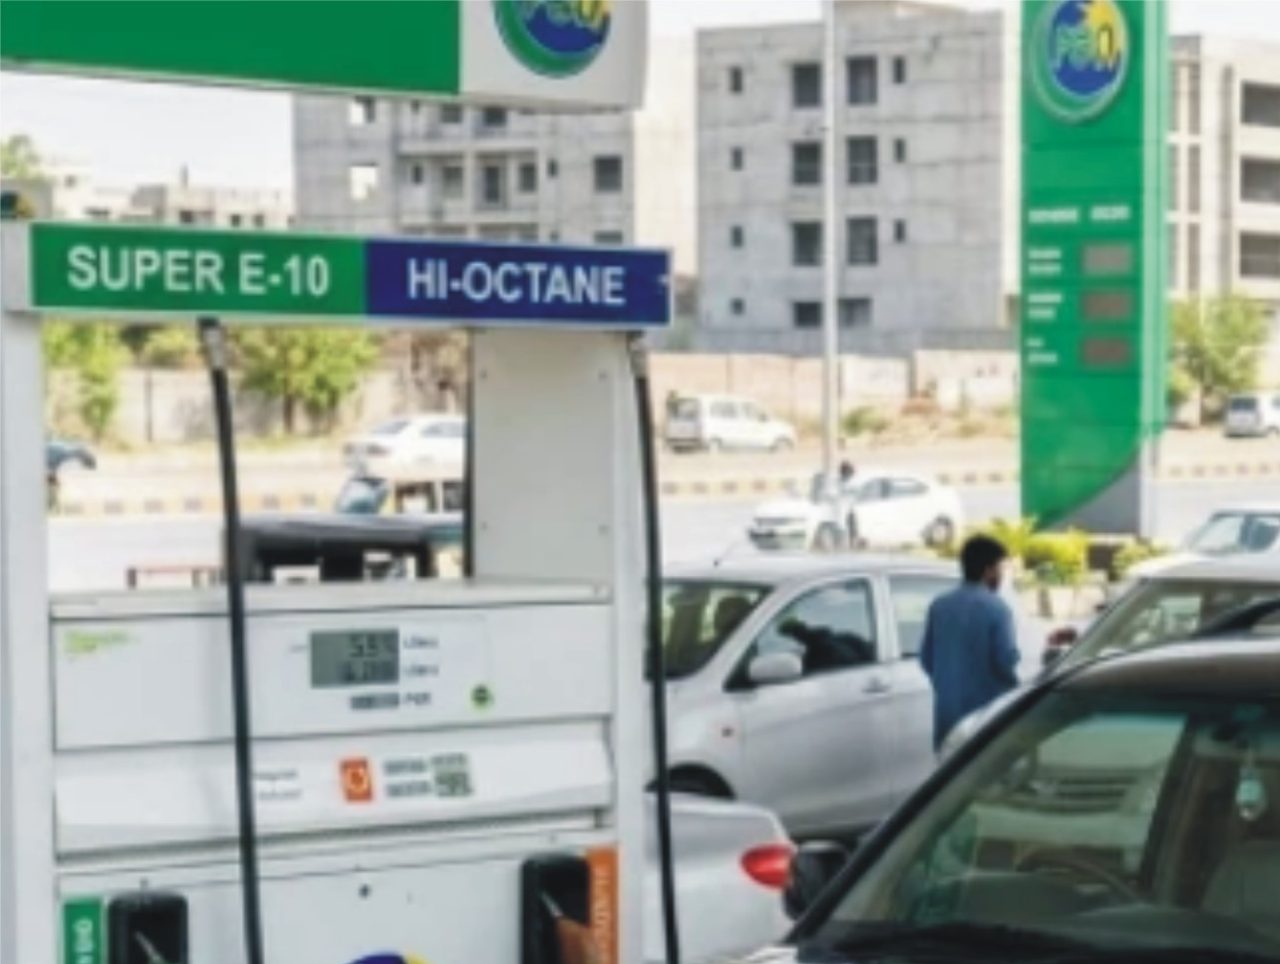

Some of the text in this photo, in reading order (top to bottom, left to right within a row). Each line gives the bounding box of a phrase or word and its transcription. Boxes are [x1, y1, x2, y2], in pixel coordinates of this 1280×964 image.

[67, 246, 330, 299] SUPER E-10
[407, 257, 628, 306] HI-OCTANE
